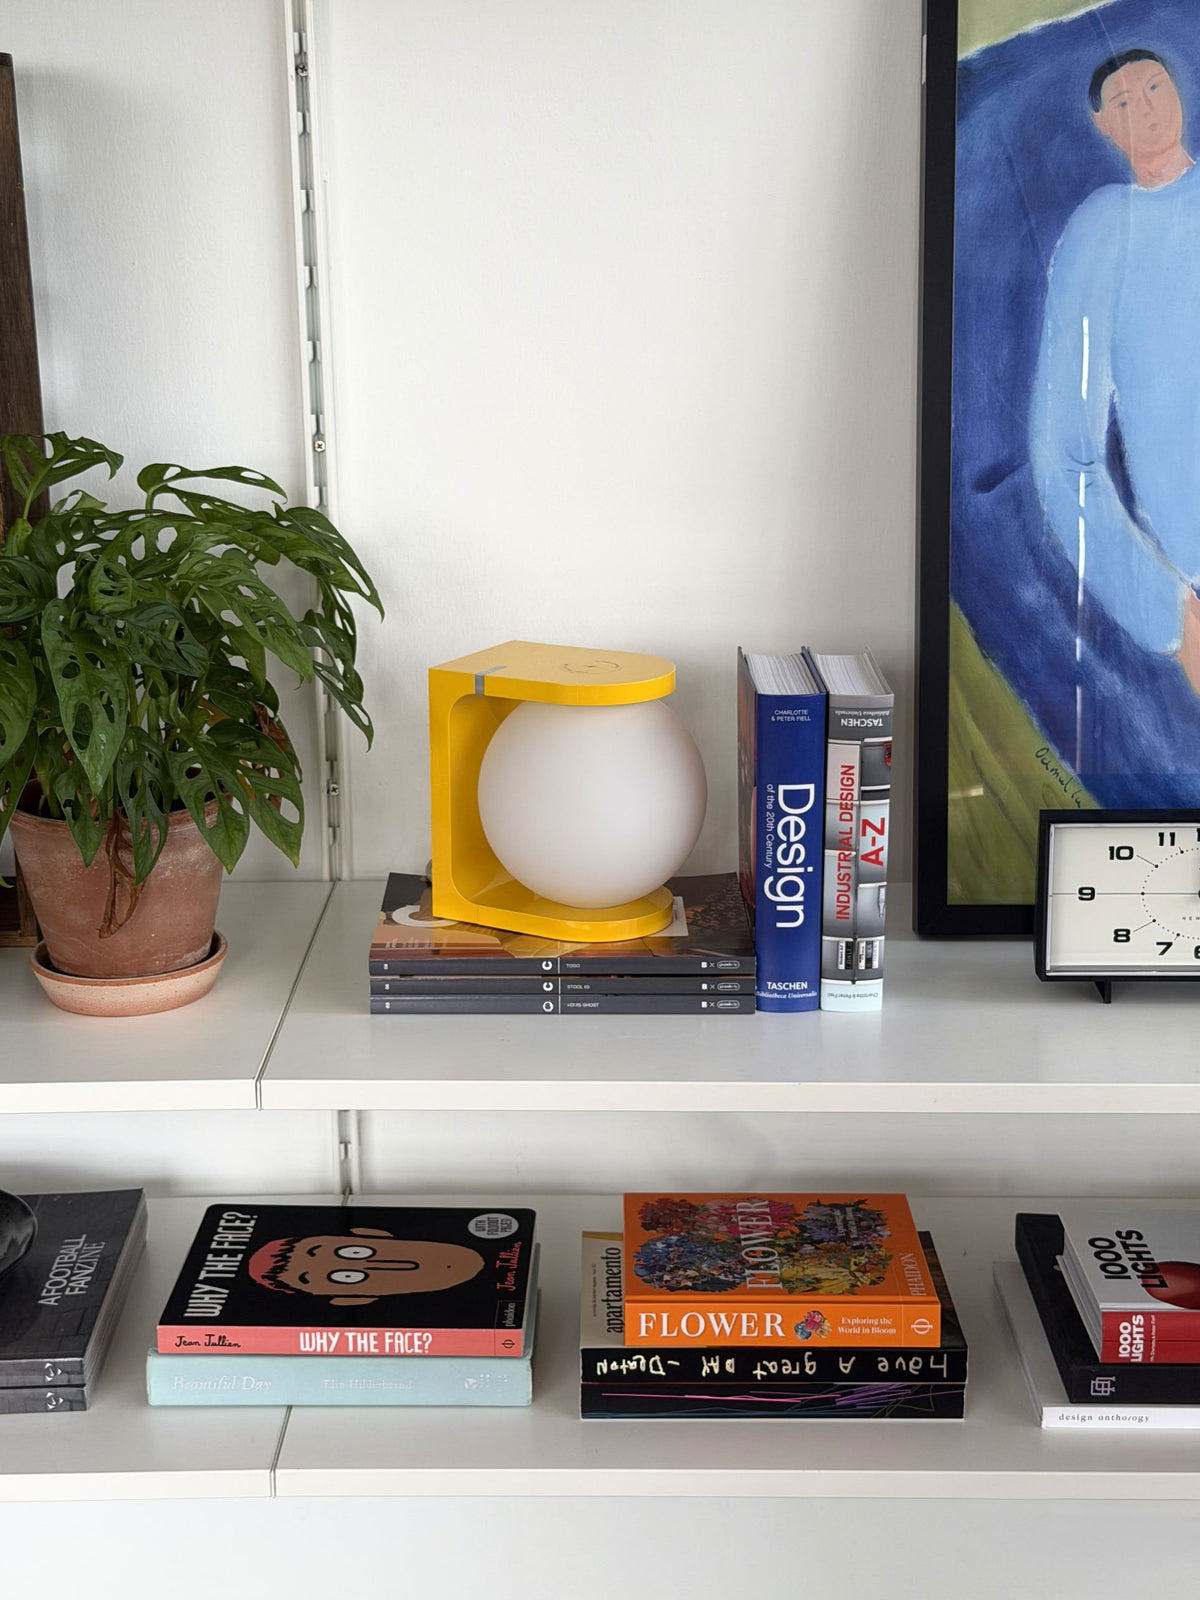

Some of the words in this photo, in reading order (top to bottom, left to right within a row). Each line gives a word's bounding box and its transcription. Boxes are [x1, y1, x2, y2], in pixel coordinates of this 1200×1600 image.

[841, 718, 884, 727] TASCHEN
[767, 784, 775, 794] of
[839, 765, 855, 822] DESIGN
[766, 796, 775, 809] the
[766, 812, 775, 832] 20th
[860, 816, 886, 867] A-Z
[1158, 832, 1175, 846] 11
[764, 834, 775, 868] Century
[764, 783, 815, 929] Design
[1109, 846, 1134, 860] 10
[836, 827, 853, 921] INDUSTRIAL
[1078, 887, 1096, 901] 9
[1113, 929, 1131, 943] 8
[1156, 942, 1173, 956] 7
[766, 981, 808, 990] TASCHEN
[210, 1211, 258, 1250] FACE?
[736, 1199, 784, 1290] FLOWER
[65, 1241, 106, 1295] FANZINE
[198, 1253, 244, 1280] THE
[1088, 1236, 1131, 1279] 1000
[1115, 1229, 1168, 1288] LIGHTS
[496, 1271, 516, 1292] Jean
[601, 1247, 624, 1333] apartamento
[184, 1284, 230, 1317] WHY
[638, 1312, 786, 1337] FLOWER
[841, 1316, 879, 1326] Exploring
[881, 1316, 893, 1325] the
[871, 1326, 896, 1334] Bloom
[175, 1335, 200, 1347] Jean
[300, 1332, 340, 1352] WHY
[345, 1332, 379, 1352] THE
[385, 1332, 433, 1353] FACE?
[1118, 1321, 1131, 1357] 1000
[1130, 1314, 1144, 1362] LIGHTS
[752, 1351, 818, 1380] great
[839, 1356, 857, 1374] A
[173, 1376, 237, 1391] Beautiful
[242, 1377, 272, 1391] Day
[1058, 1413, 1093, 1422] design
